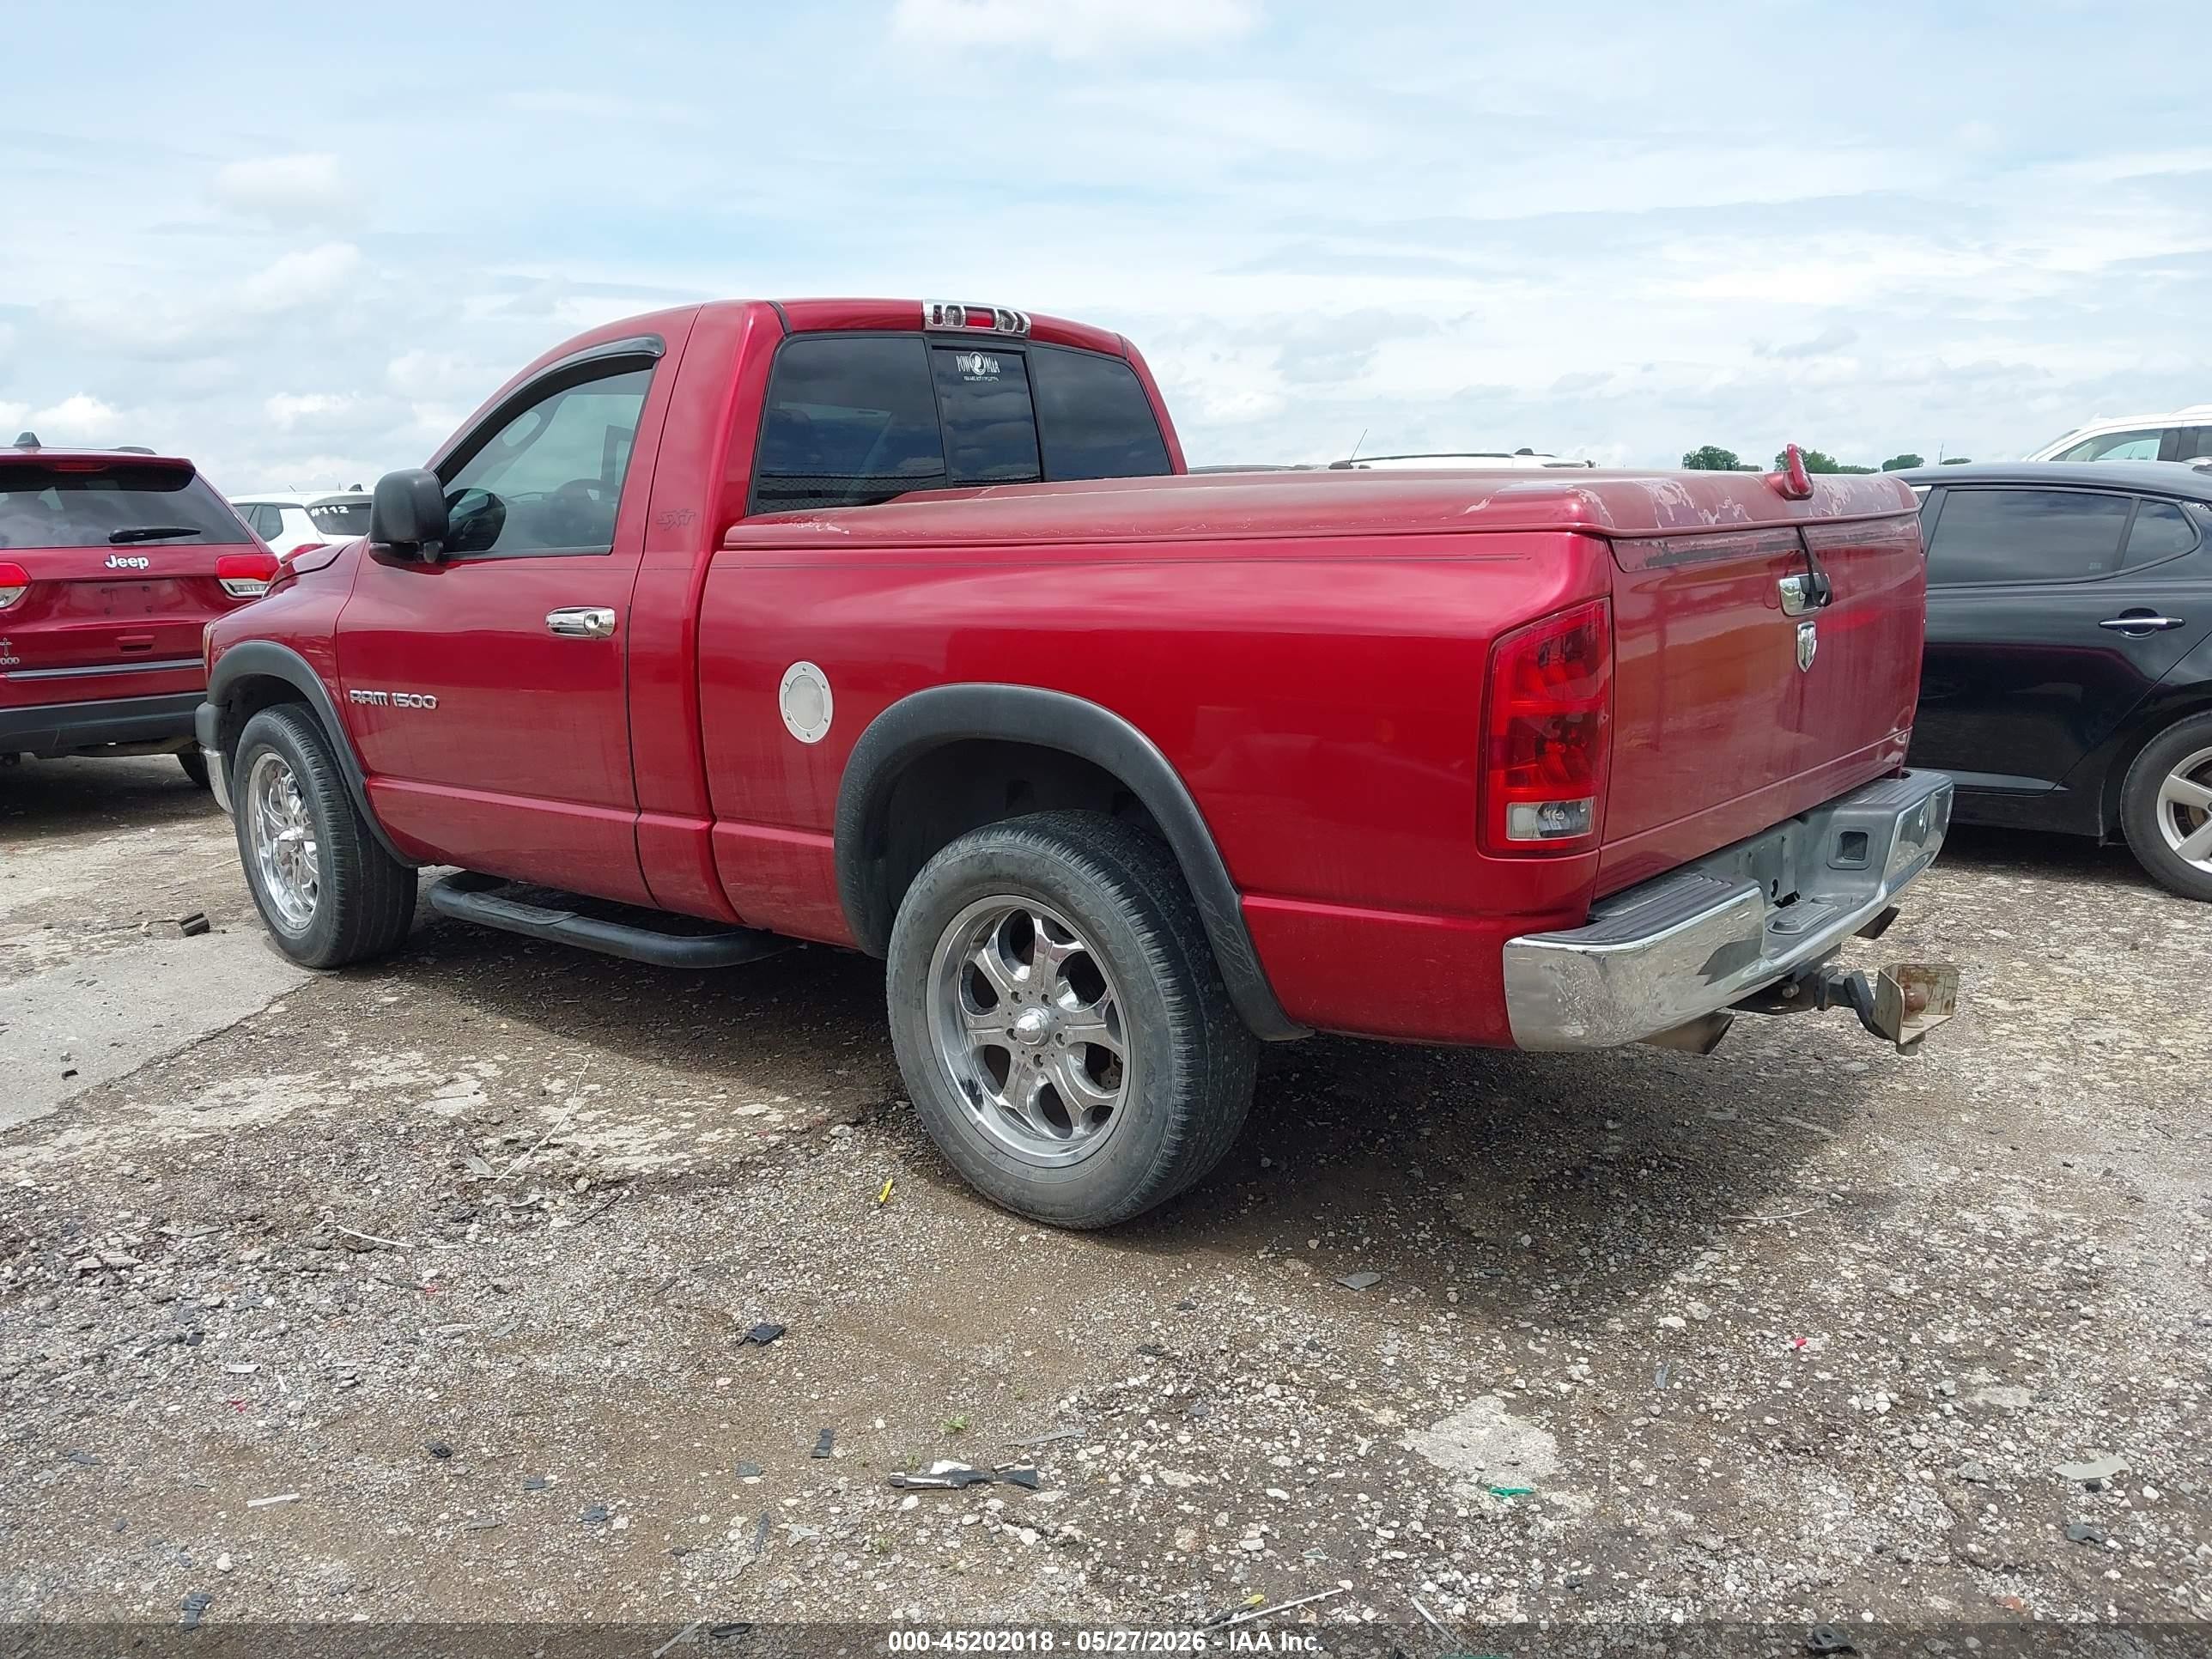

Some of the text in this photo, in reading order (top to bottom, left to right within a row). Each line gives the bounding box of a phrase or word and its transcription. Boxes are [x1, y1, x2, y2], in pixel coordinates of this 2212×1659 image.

[956, 356, 1000, 374] POW MIA
[310, 506, 349, 518] #112
[104, 554, 149, 570] Jeep
[349, 690, 440, 709] RAM 1500
